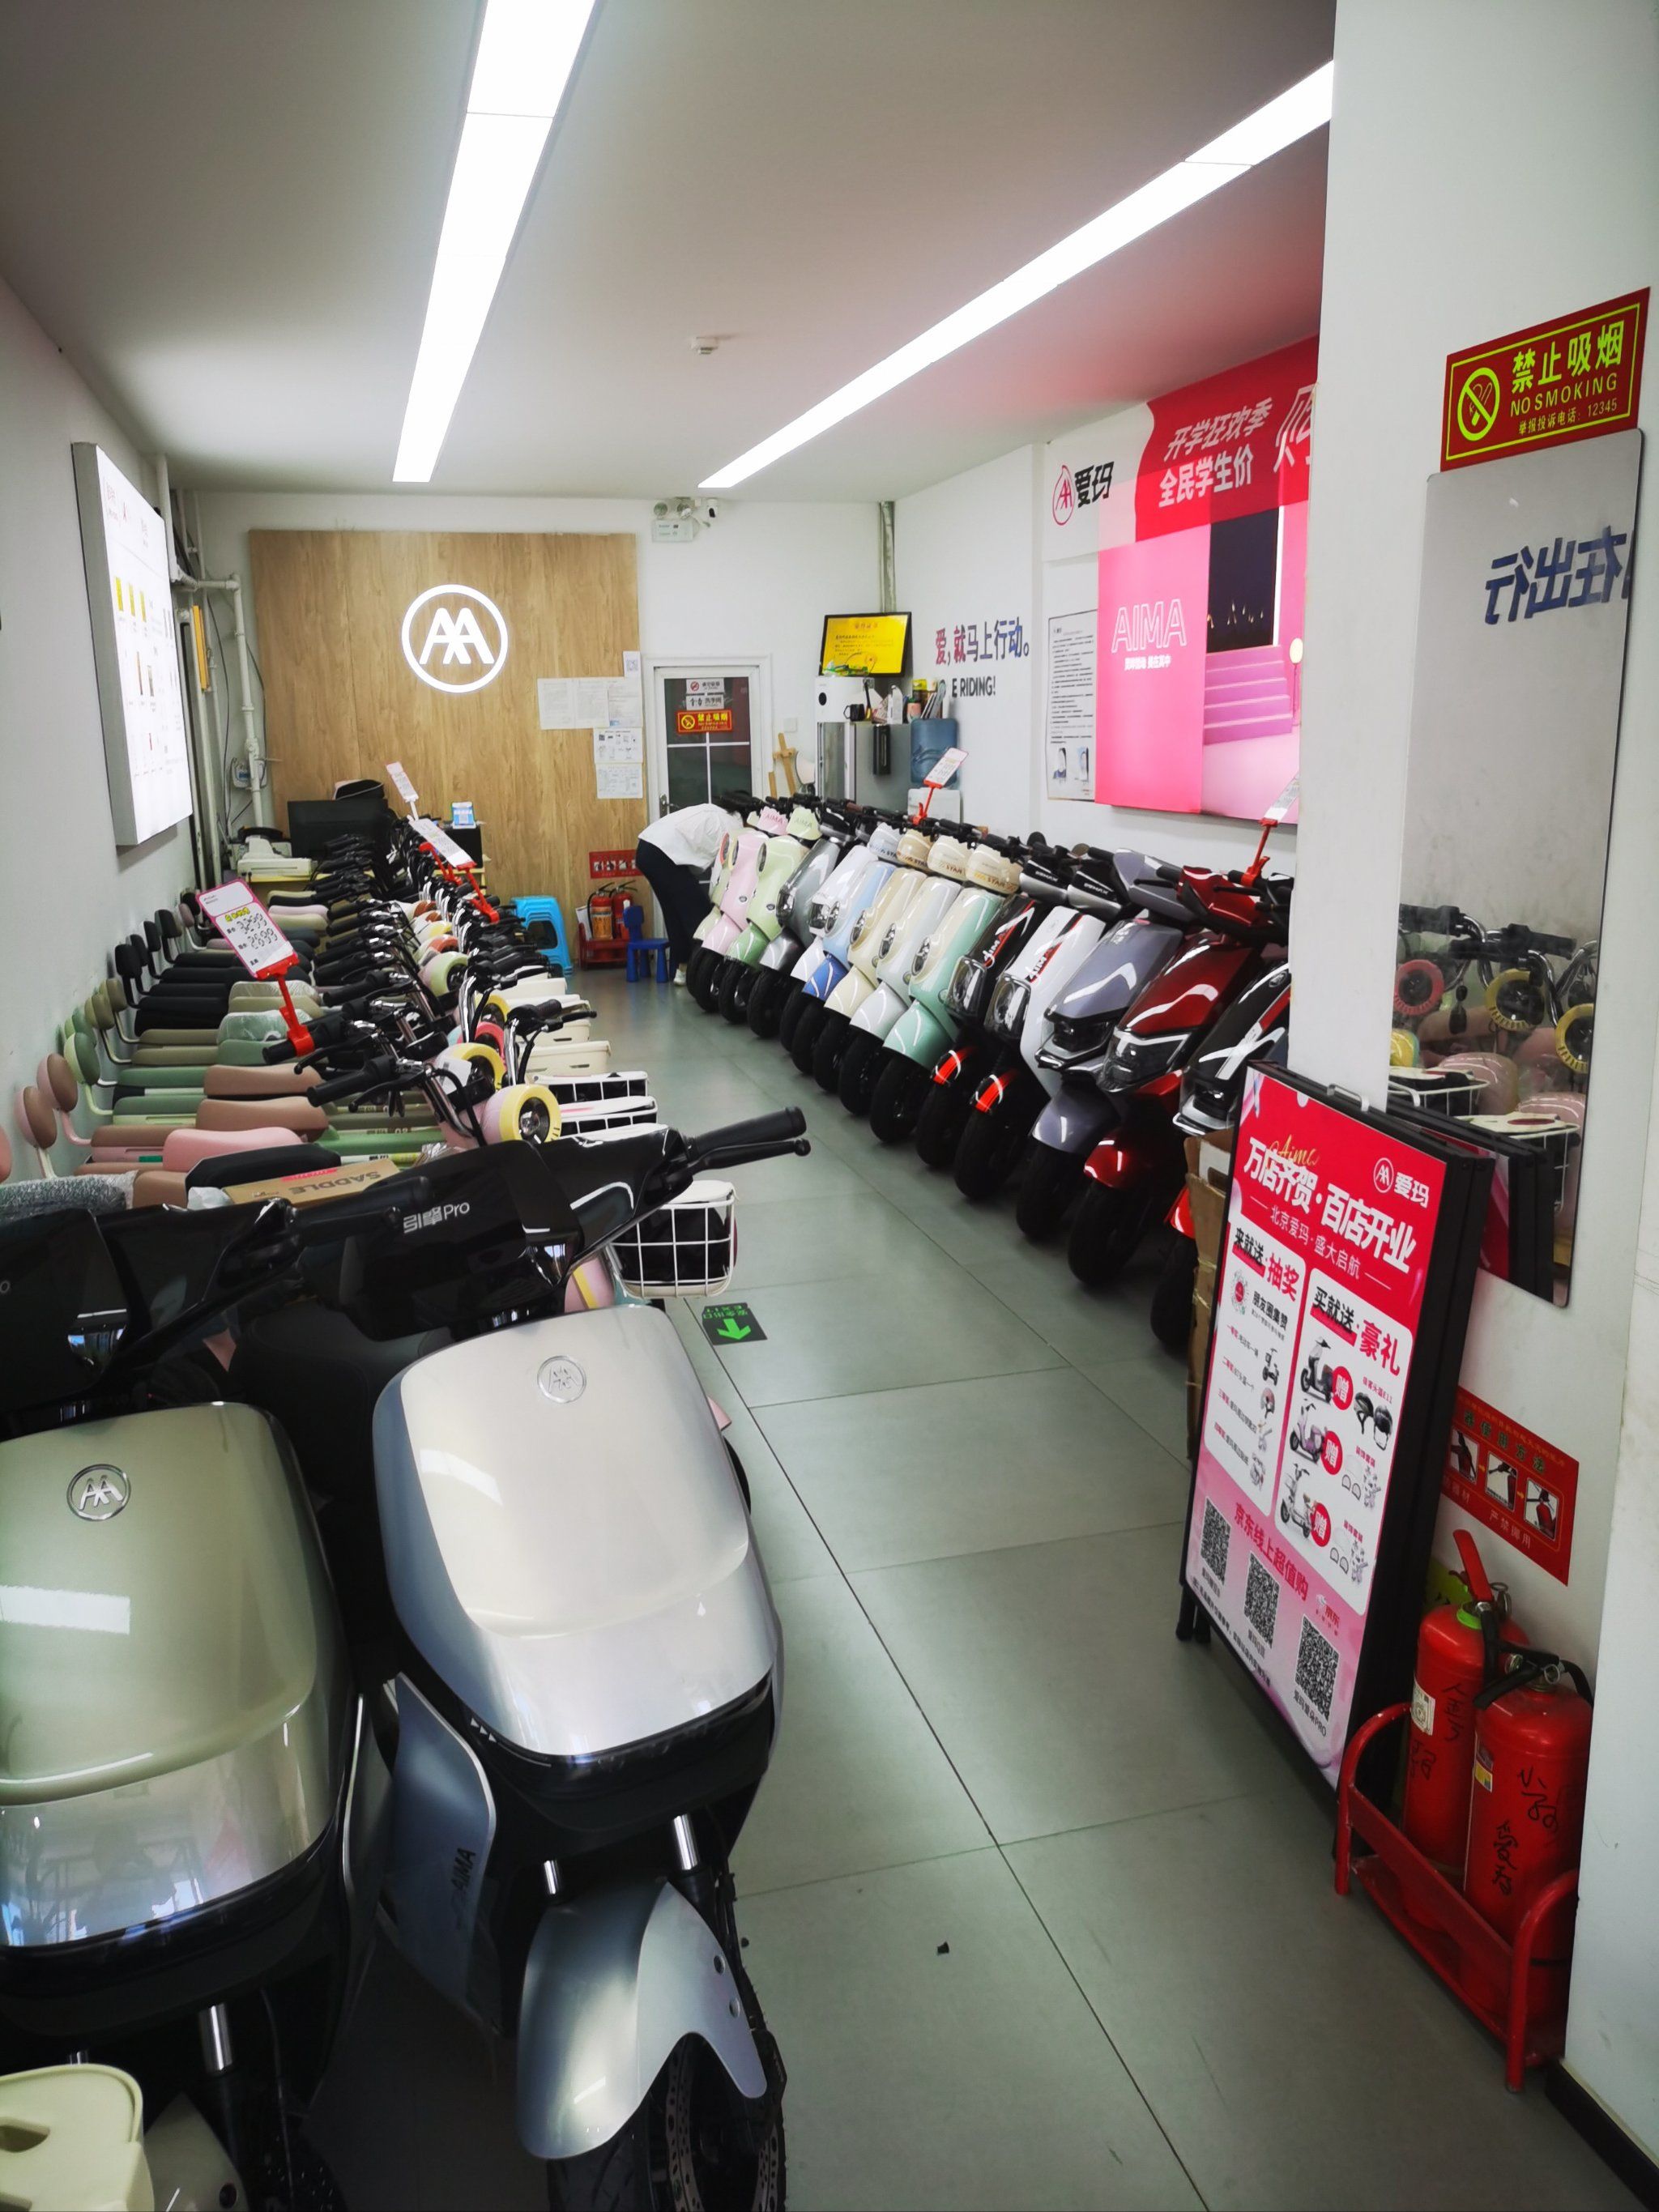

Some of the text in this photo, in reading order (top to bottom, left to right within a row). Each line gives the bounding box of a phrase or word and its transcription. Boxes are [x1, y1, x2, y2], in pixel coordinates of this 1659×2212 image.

[1512, 320, 1625, 394] 禁止吸烟
[1164, 397, 1273, 462] 开学狂欢季
[1074, 461, 1115, 509] 爱玛
[1158, 444, 1253, 508] 全民学生价
[1111, 599, 1188, 654] AIMA
[960, 676, 996, 697] RIDING!
[288, 1171, 382, 1195] SADDLE
[1394, 1171, 1430, 1208] 爱玛
[1269, 1204, 1362, 1281] 北京爱玛·盛大启航
[1252, 1289, 1288, 1332] 朋友圈集赞
[1333, 1374, 1349, 1404] 赠
[1324, 1438, 1338, 1469] 赠
[1313, 1509, 1328, 1541] 赠
[1234, 1500, 1309, 1603] 京东线上超值购
[451, 1848, 476, 1890] AIMA
